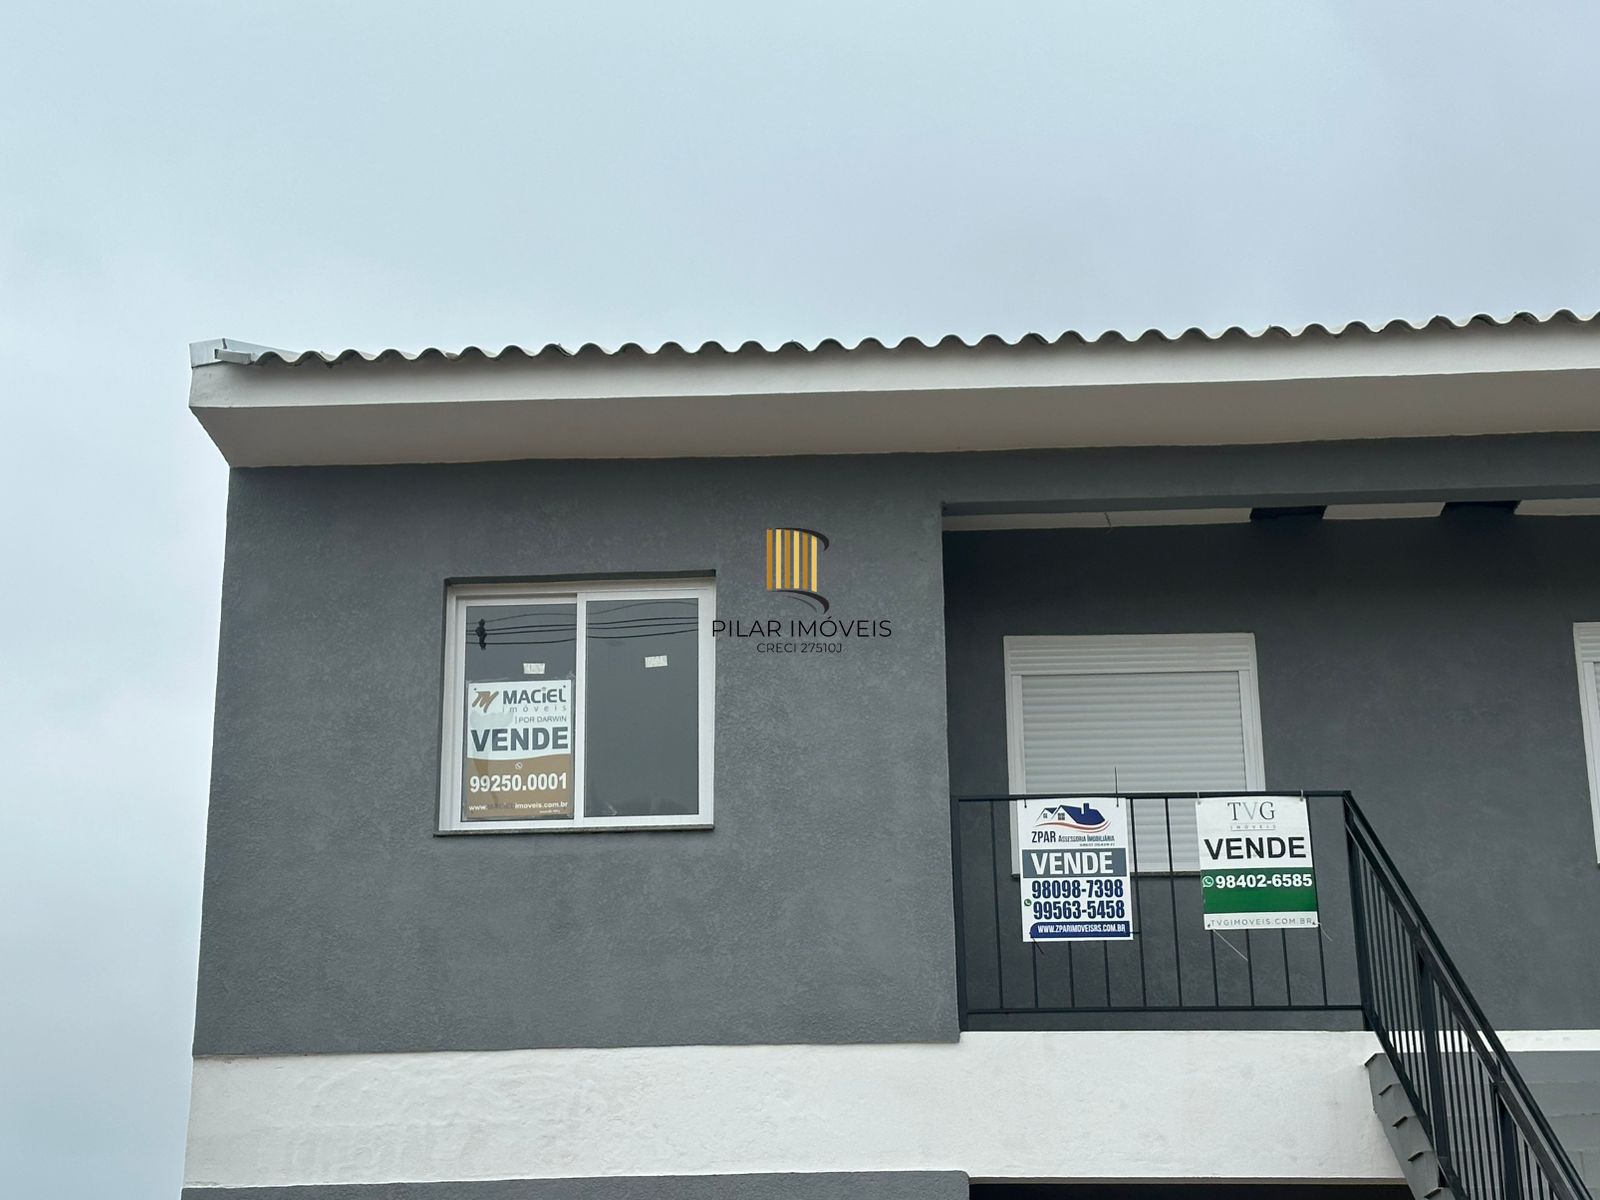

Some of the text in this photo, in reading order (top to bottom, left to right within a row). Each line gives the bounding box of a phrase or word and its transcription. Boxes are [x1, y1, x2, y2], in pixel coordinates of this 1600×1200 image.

[502, 705, 567, 713] imóveis
[471, 726, 568, 752] VENDE
[470, 772, 567, 792] 99250.0001
[1227, 801, 1275, 820] TVG
[1031, 831, 1056, 843] ZPAR
[1204, 836, 1306, 860] VENDE
[1031, 852, 1113, 875] VENDE
[1032, 879, 1124, 899] 98098-7398
[1216, 874, 1312, 889] 98402-6585
[1033, 900, 1125, 920] 99563-5458
[1210, 917, 1312, 926] TVGIMOVEIS.COM.BR
